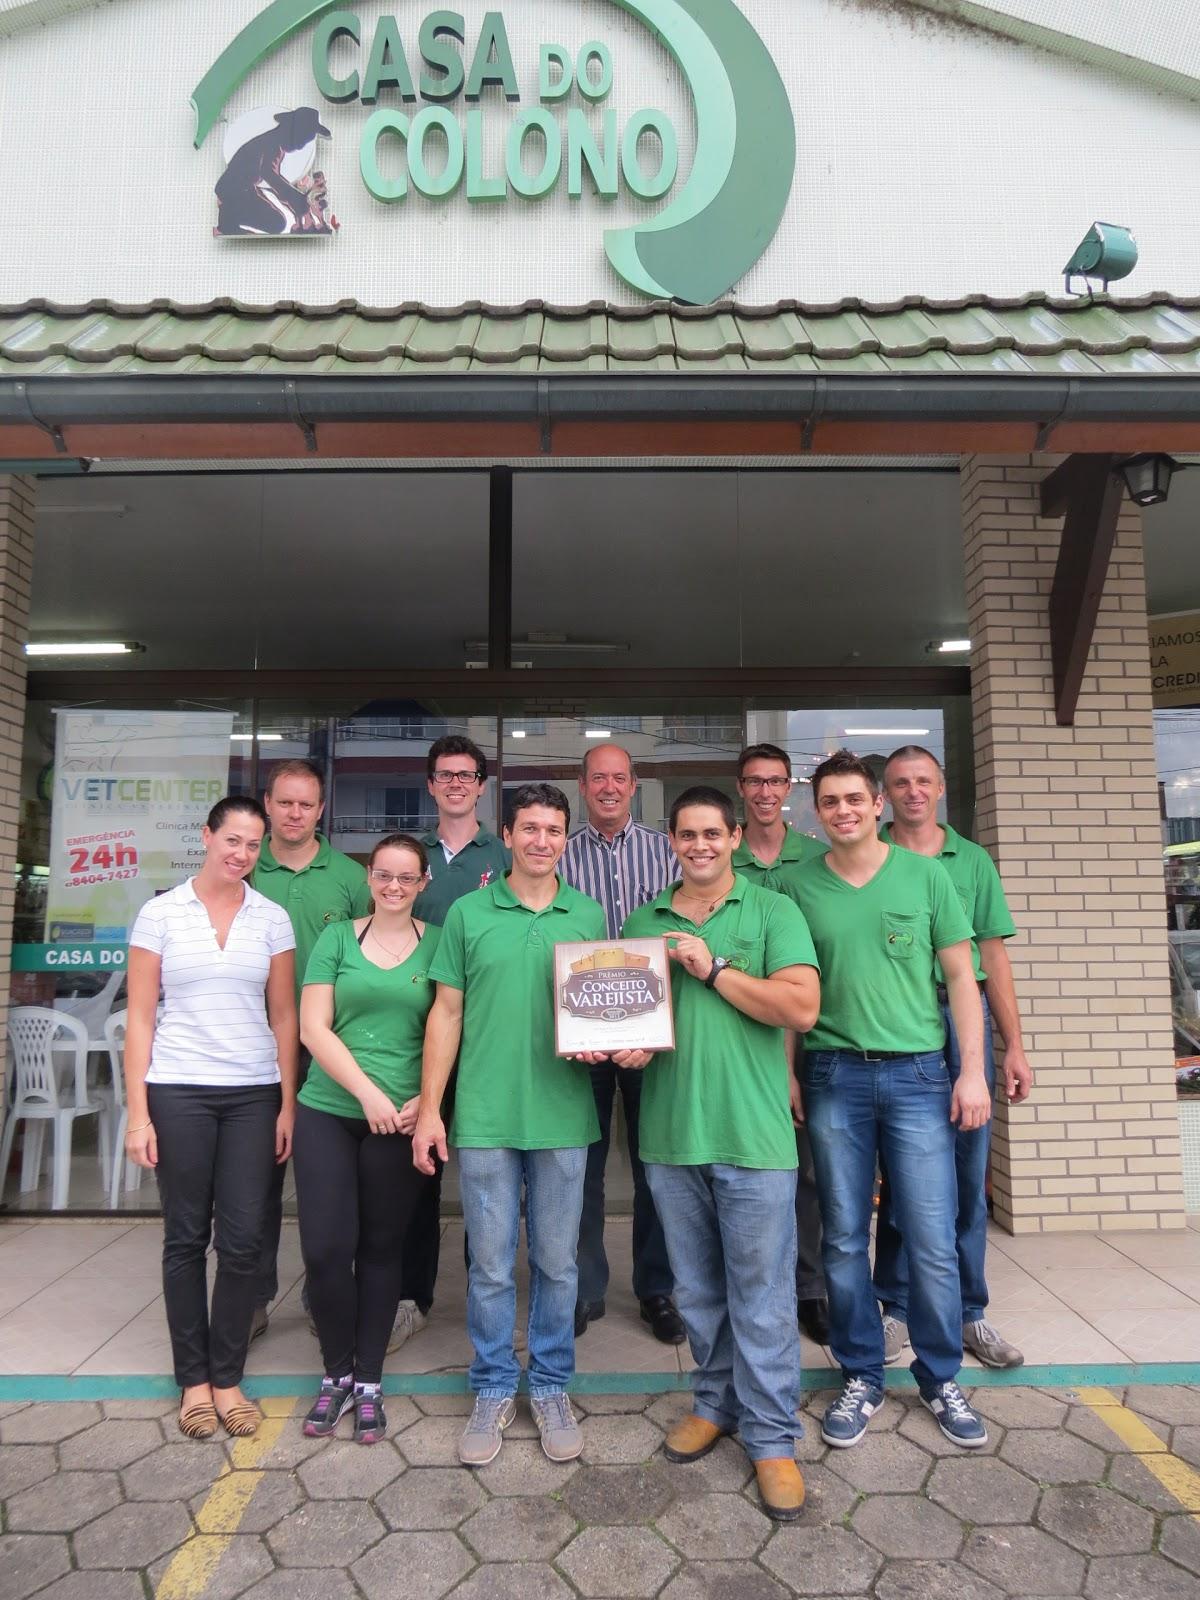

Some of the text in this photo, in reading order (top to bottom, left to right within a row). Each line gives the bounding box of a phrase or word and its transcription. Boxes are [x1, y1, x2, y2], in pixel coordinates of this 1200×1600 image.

[312, 10, 613, 105] CASA DO
[359, 106, 679, 204] COLONO
[61, 779, 223, 802] VETCENTER
[65, 830, 137, 846] EMERGÊNCIA
[69, 842, 138, 874] 24h
[46, 950, 126, 965] CASA DO
[582, 979, 647, 993] CONCEITO
[568, 990, 656, 1008] VAREJISTA
